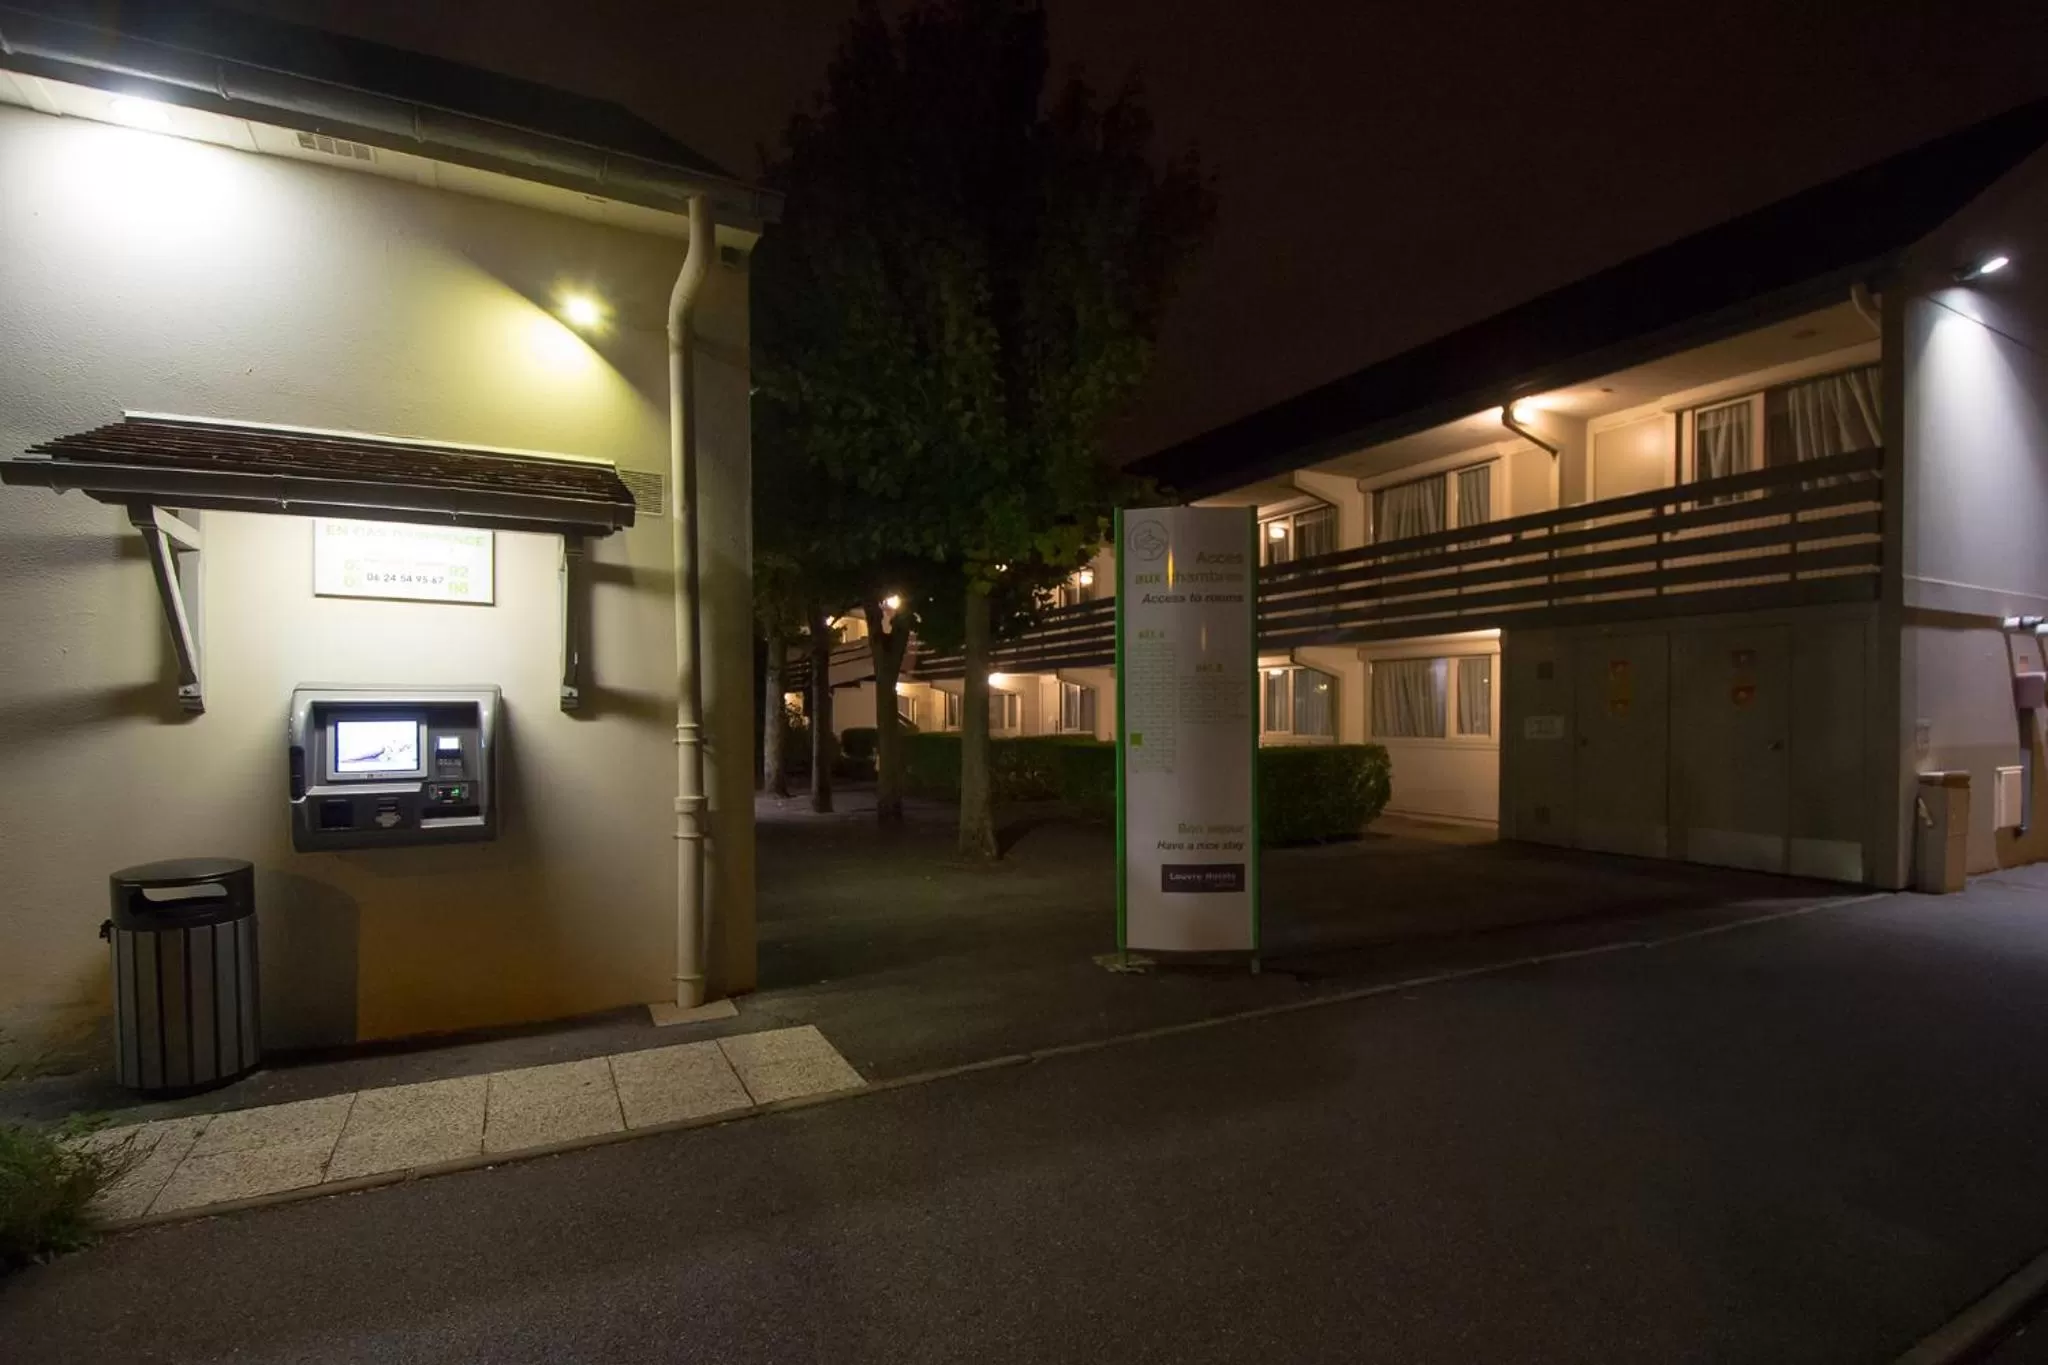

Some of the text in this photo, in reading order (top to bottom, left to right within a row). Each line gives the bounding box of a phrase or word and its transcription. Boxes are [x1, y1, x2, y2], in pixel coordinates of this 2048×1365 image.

[383, 573, 396, 584] 24
[400, 574, 412, 584] 54
[1141, 592, 1186, 605] Access
[1190, 592, 1202, 603] to
[1156, 839, 1184, 850] Have
[1196, 841, 1220, 850] nice
